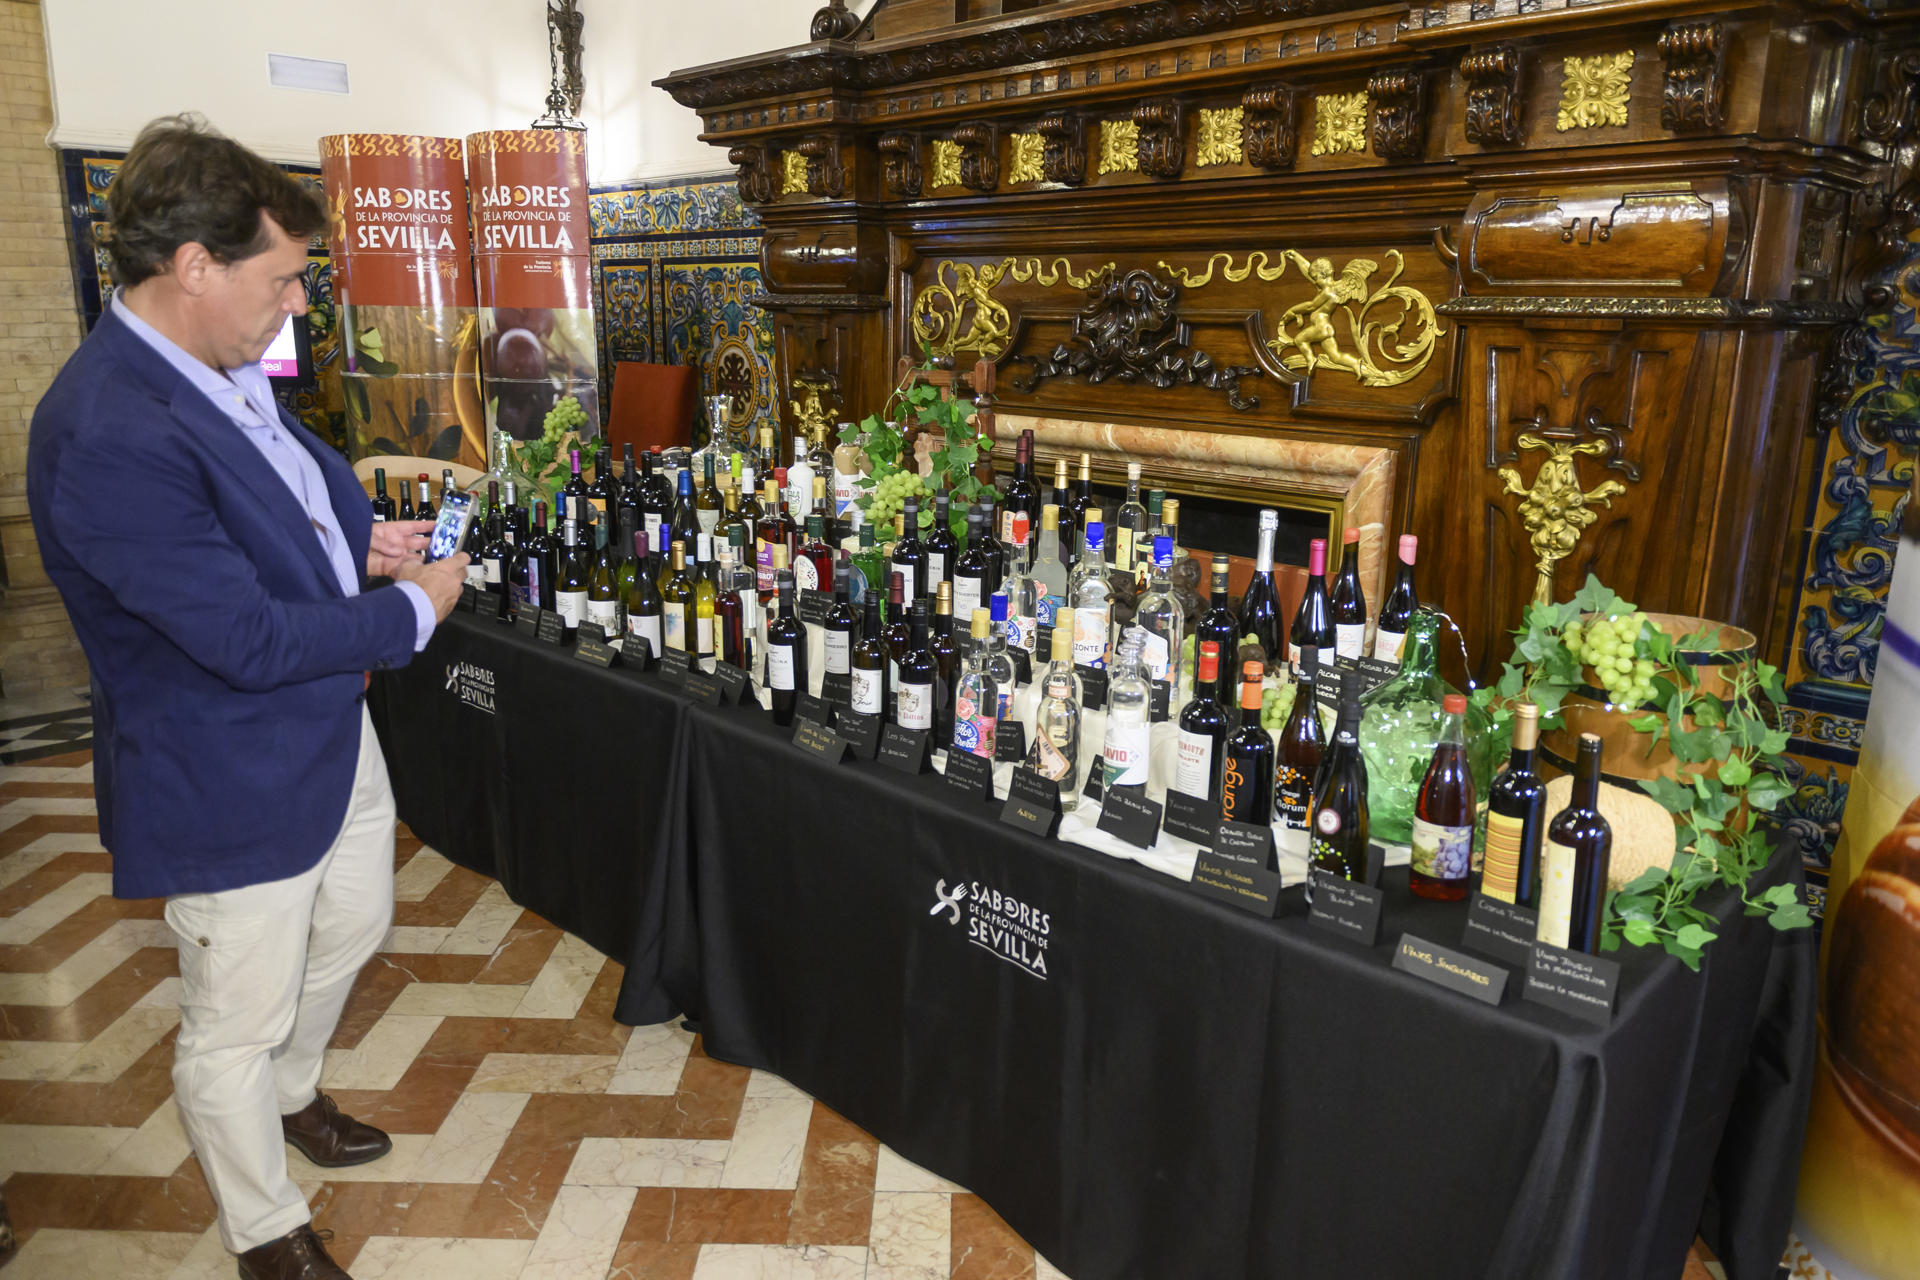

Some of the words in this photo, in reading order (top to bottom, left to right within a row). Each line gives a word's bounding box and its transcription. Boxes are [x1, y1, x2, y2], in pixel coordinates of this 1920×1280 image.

[354, 187, 452, 211] SABORES
[482, 185, 571, 208] SABORES
[355, 212, 366, 222] DE
[368, 212, 380, 221] LA
[382, 212, 438, 223] PROVINCIA
[440, 214, 453, 225] DE
[483, 211, 491, 221] DE
[492, 211, 502, 221] LA
[503, 211, 555, 221] PROVINCIA
[558, 212, 571, 221] DE
[357, 225, 456, 250] SEVILLA
[484, 225, 574, 249] SEVILLA
[460, 661, 495, 685] SABORES
[461, 685, 496, 711] SEVILLA
[1104, 744, 1127, 762] AVID
[970, 881, 1050, 935] SABORES
[969, 903, 980, 915] DE
[981, 909, 991, 920] LA
[991, 915, 1037, 945] PROVINCIA
[1038, 937, 1048, 949] DE
[968, 916, 1048, 975] SEVILLA
